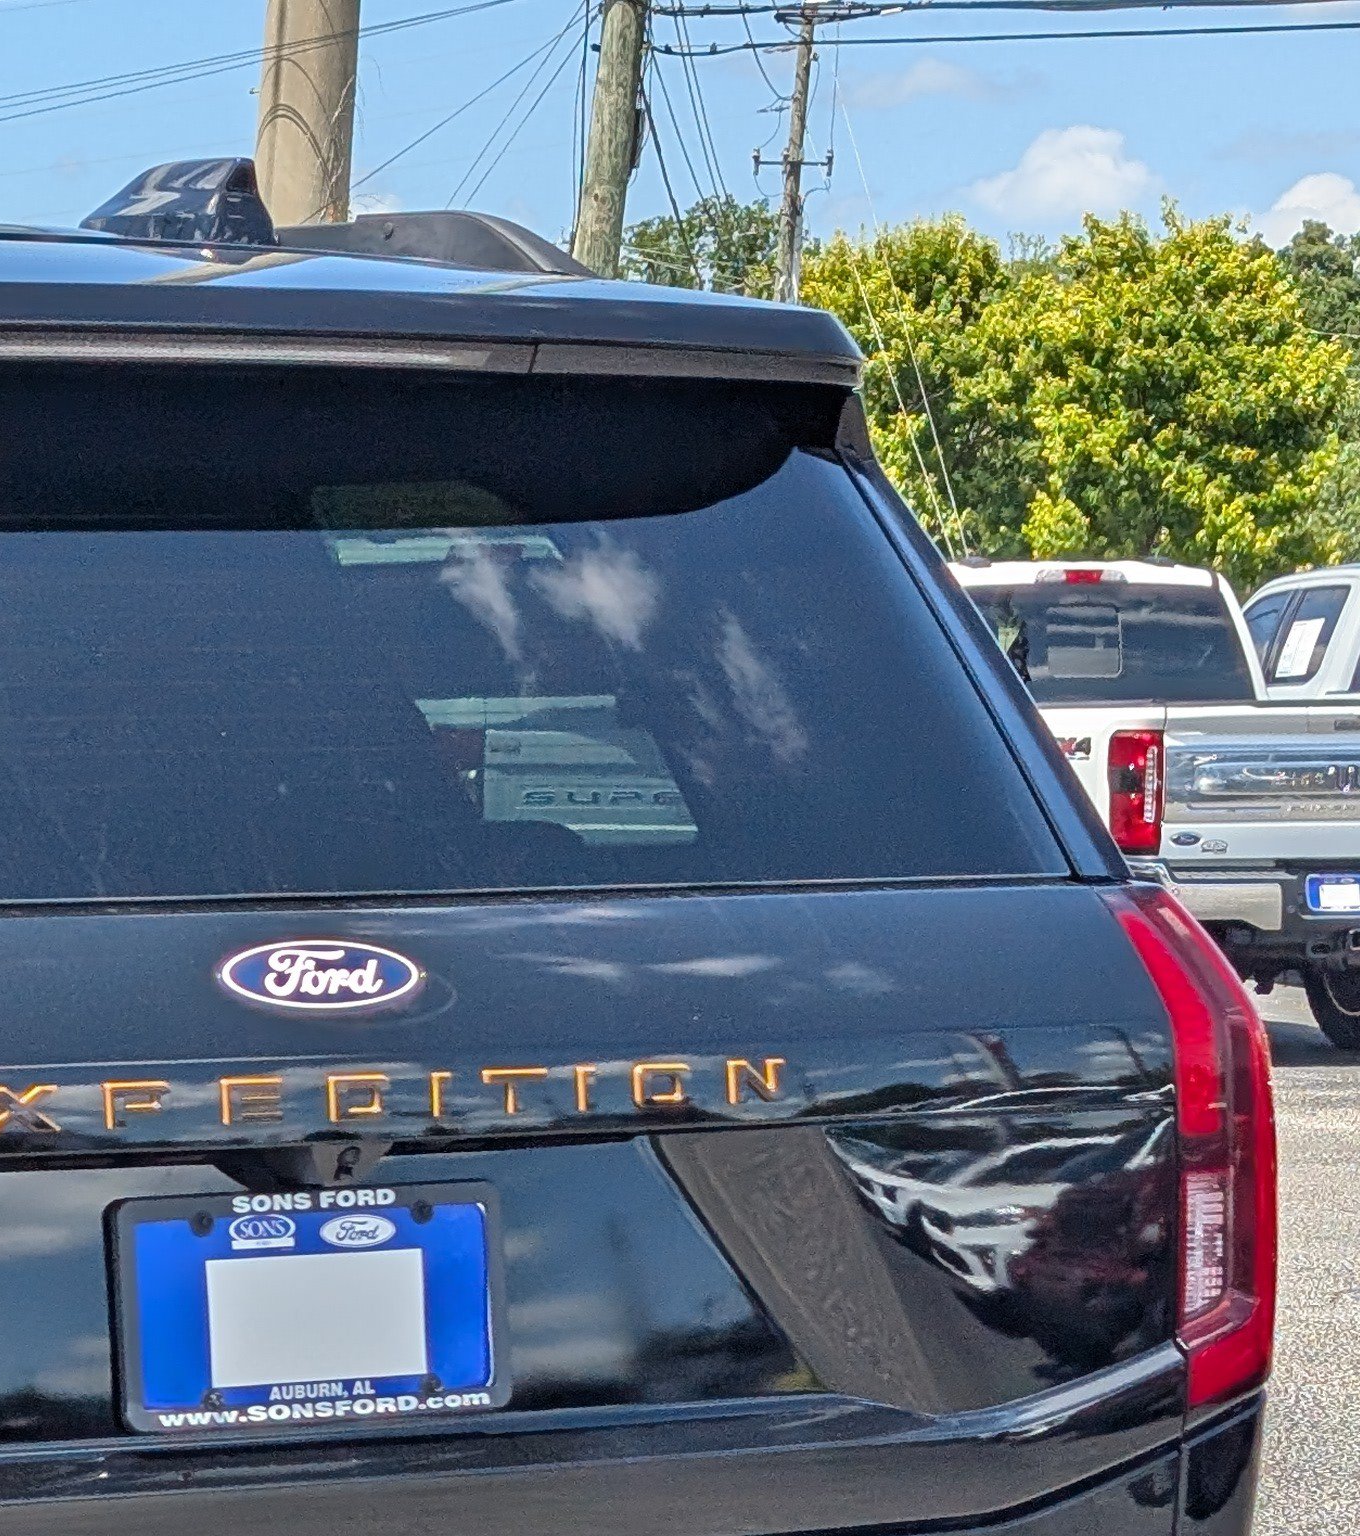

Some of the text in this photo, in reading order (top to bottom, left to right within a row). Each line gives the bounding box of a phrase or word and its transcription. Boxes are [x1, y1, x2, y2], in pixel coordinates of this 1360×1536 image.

[264, 949, 383, 997] Ford
[232, 1188, 396, 1214] SONS FORD
[239, 1218, 286, 1239] SONS
[335, 1220, 380, 1241] Ford
[269, 1379, 376, 1401] AUBURN, AL
[158, 1391, 491, 1428] www.SONSFORD.com
